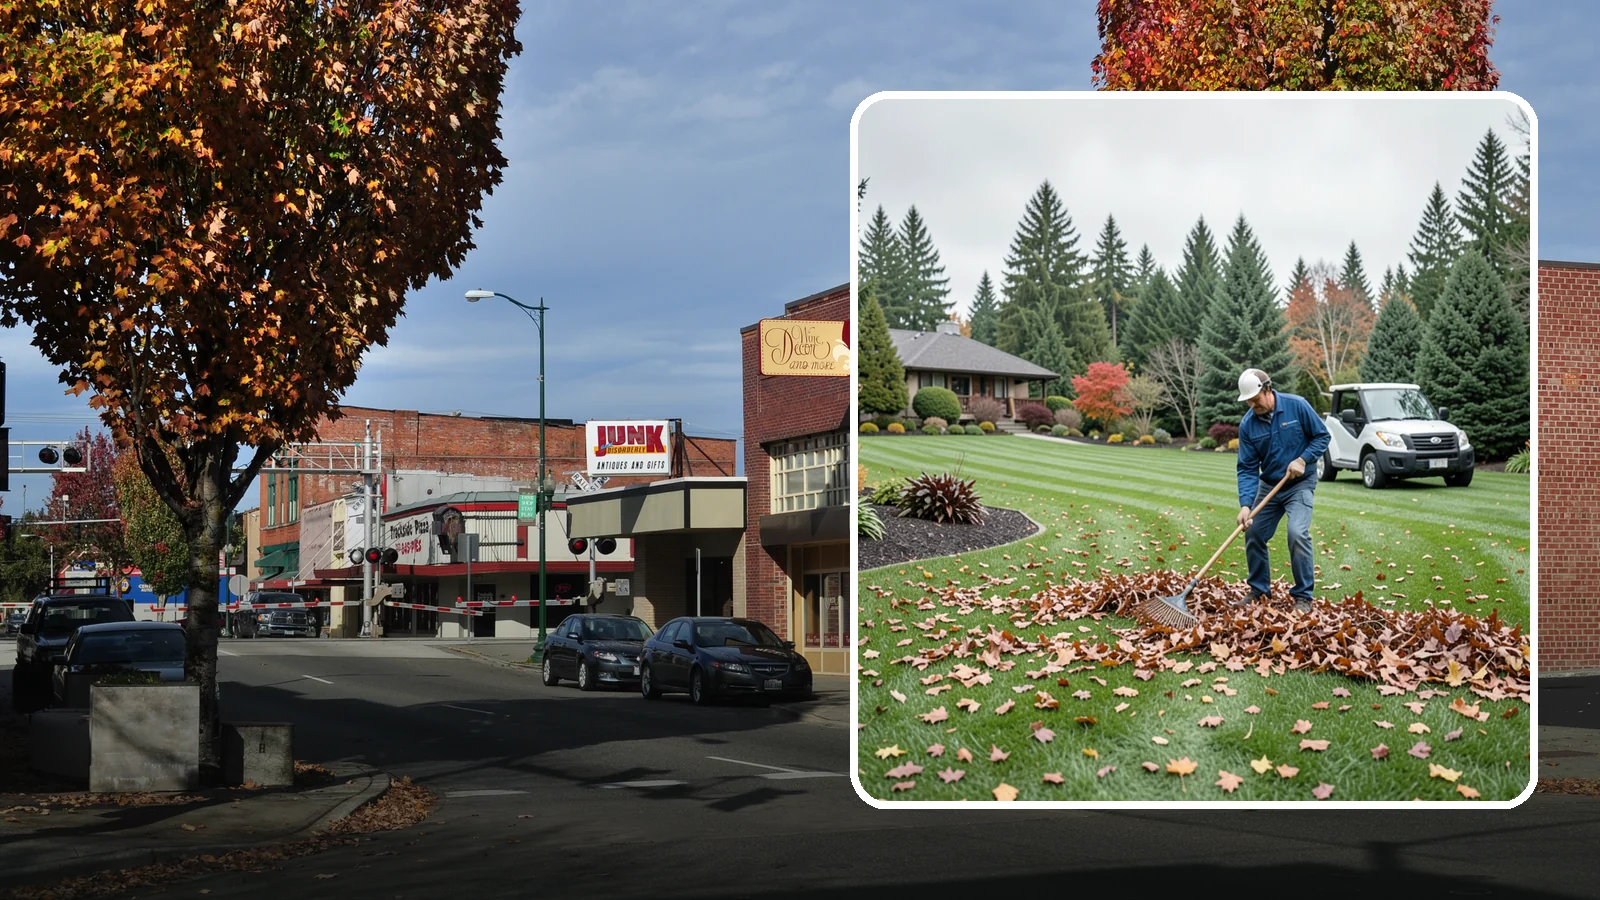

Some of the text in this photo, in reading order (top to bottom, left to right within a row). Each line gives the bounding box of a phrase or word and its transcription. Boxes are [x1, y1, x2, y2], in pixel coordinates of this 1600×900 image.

[596, 425, 664, 457] JUNK
[597, 461, 665, 470] ANTIQUES AND GIFTS
[390, 520, 429, 540] Trackside Pizza
